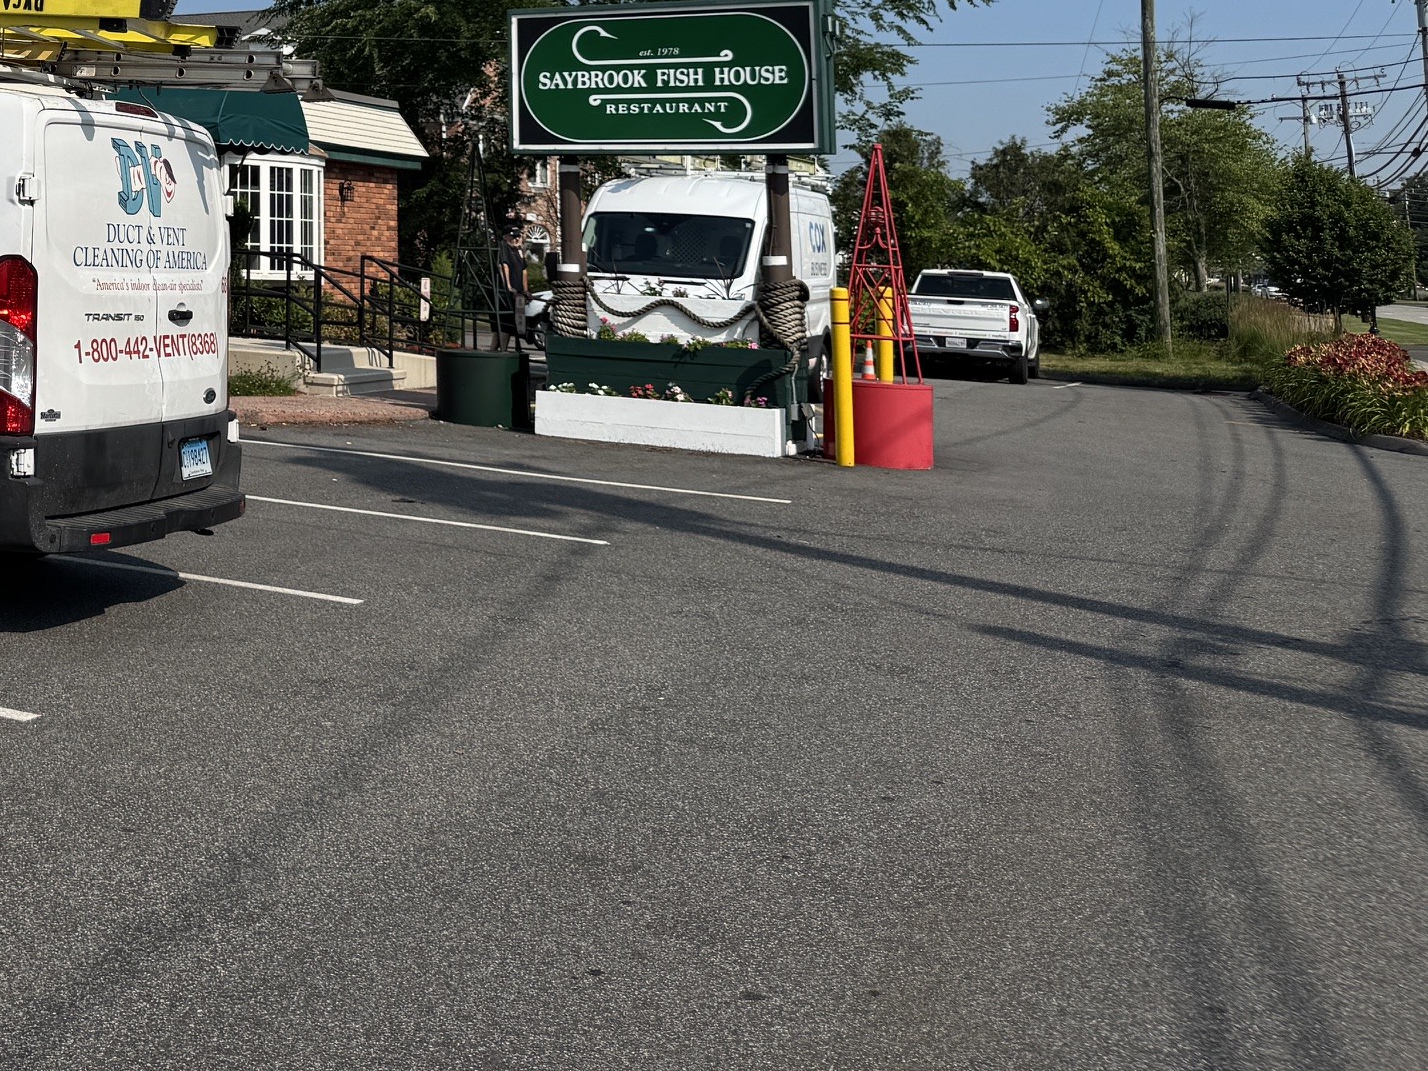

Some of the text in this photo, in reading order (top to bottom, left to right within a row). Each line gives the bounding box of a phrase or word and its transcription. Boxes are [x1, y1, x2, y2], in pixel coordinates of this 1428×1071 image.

[657, 46, 680, 56] 1978
[538, 65, 789, 90] SAYBROOK FISH HOUSE
[605, 101, 729, 115] RESTAURANT
[106, 223, 187, 247] DUCT & VENT
[809, 221, 827, 253] COX
[73, 246, 208, 271] CLEANING OF AMERICA
[130, 278, 151, 291] indoor
[84, 313, 133, 322] TRANSIT
